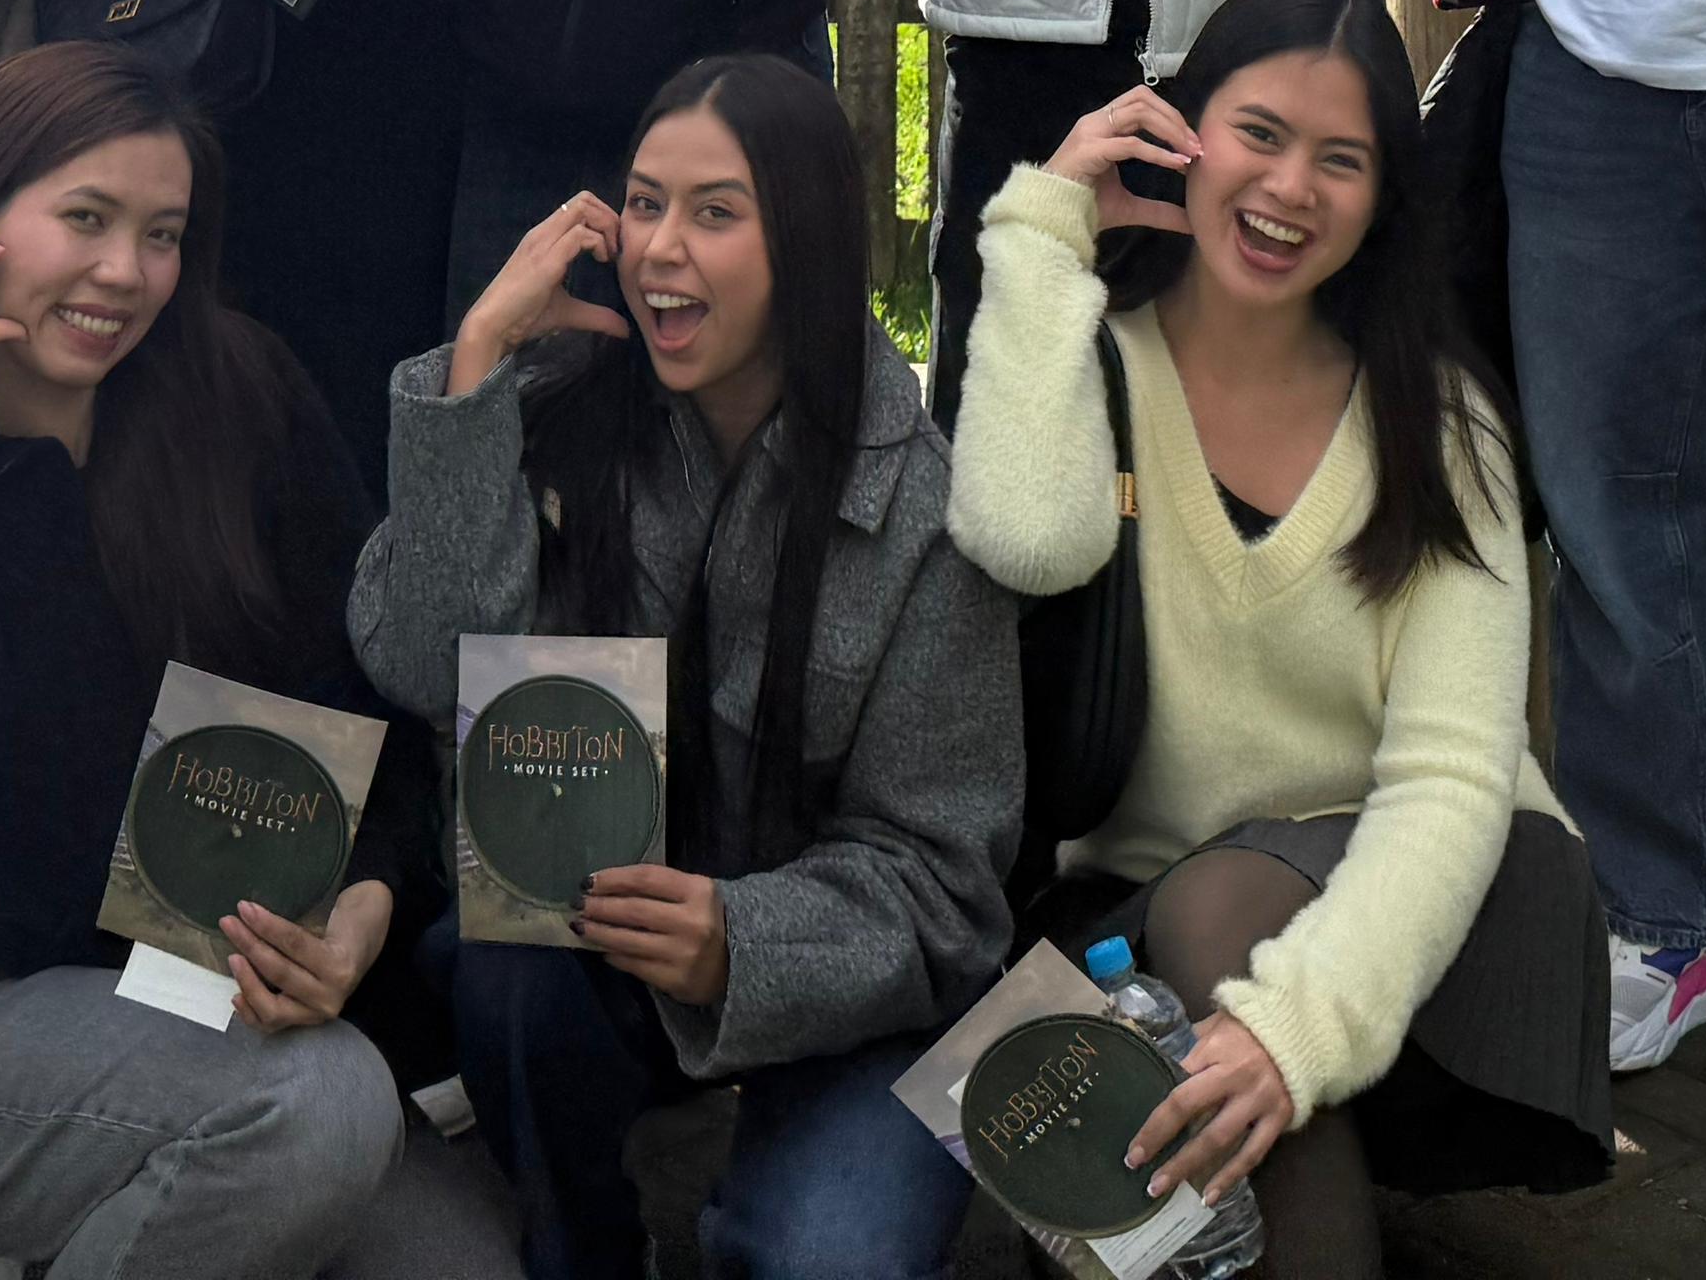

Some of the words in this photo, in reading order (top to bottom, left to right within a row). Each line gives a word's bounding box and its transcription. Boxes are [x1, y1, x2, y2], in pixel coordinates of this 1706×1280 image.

[488, 724, 626, 771] HOBBITON
[513, 763, 565, 777] MOVIE
[572, 766, 600, 778] SET
[167, 753, 324, 823] HOBBITON
[193, 794, 248, 822] MOVIE
[255, 813, 285, 832] SET
[978, 1031, 1099, 1163] HOBBITON
[1024, 1100, 1069, 1145] MOVIE
[1069, 1076, 1094, 1103] SET
